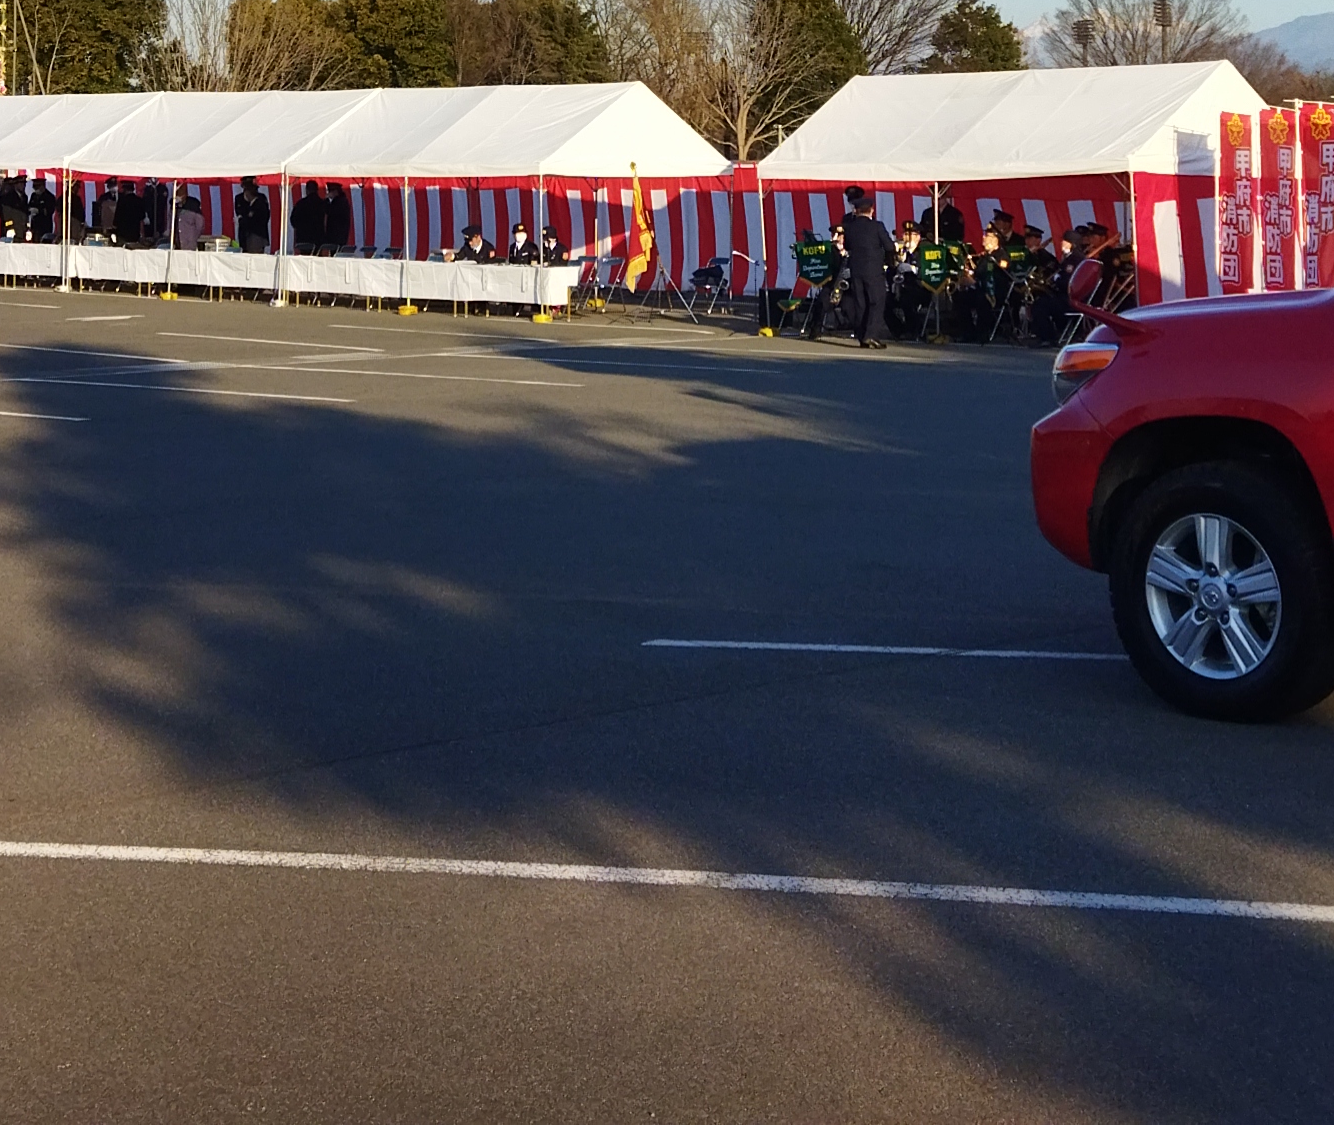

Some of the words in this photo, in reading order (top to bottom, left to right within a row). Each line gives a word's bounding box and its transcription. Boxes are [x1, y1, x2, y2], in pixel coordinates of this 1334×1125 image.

[1235, 148, 1252, 235] 甲府市
[1278, 147, 1293, 236] 甲府市
[802, 245, 826, 256] KOFU
[1222, 195, 1240, 282] 消防団
[1265, 195, 1284, 283] 消防団
[1306, 194, 1319, 284] 消防団
